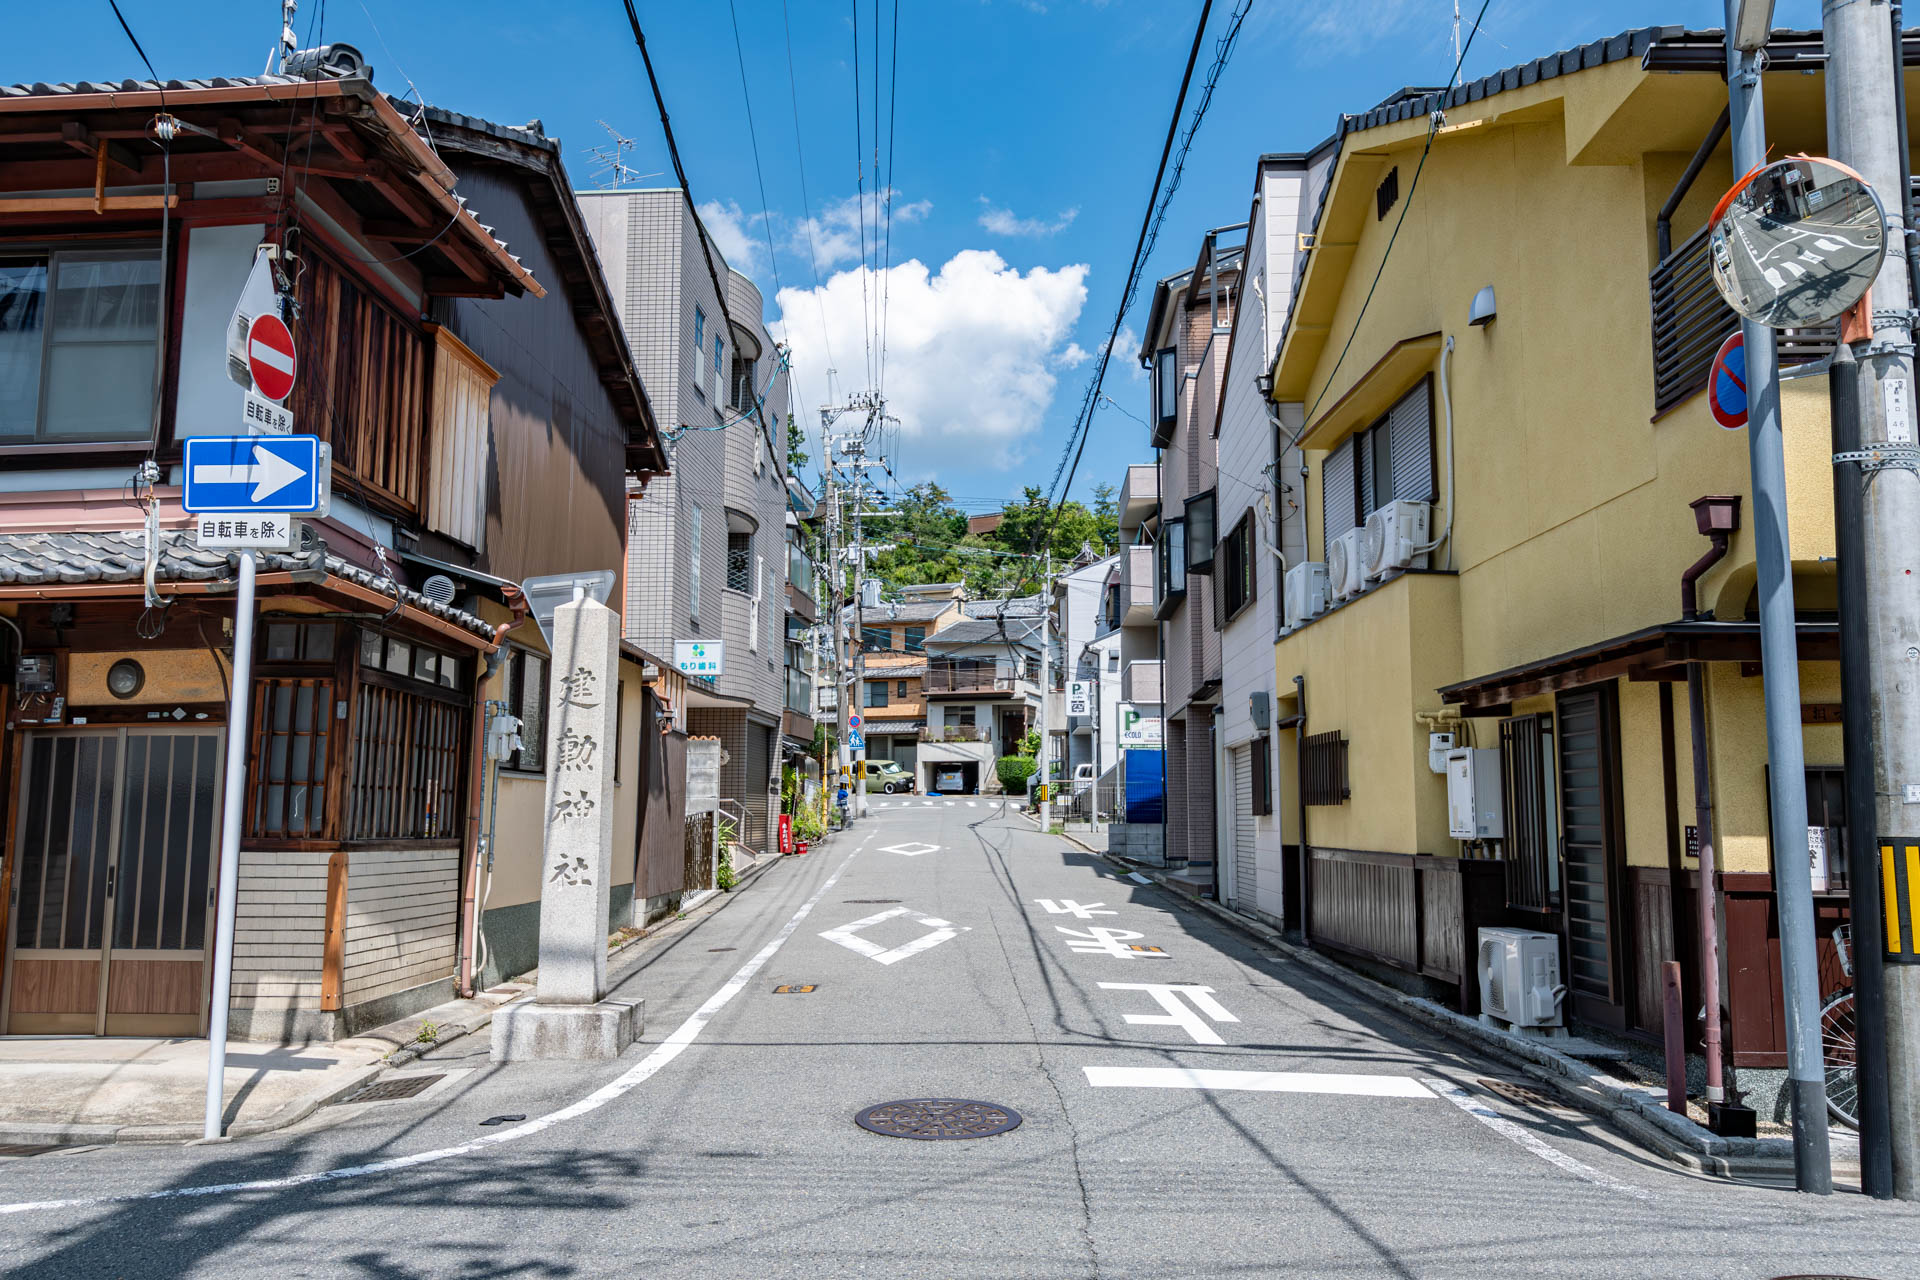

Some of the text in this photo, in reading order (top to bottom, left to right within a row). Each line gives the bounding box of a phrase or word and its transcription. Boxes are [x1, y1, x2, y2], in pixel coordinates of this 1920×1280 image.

[246, 399, 291, 436] 自転車を除く
[202, 520, 286, 540] 自転車を除く
[680, 661, 717, 671] もり歯科
[1071, 683, 1082, 695] P
[1125, 711, 1140, 731] P
[548, 666, 600, 890] 建勲神社
[1033, 898, 1241, 1046] 止まれ
